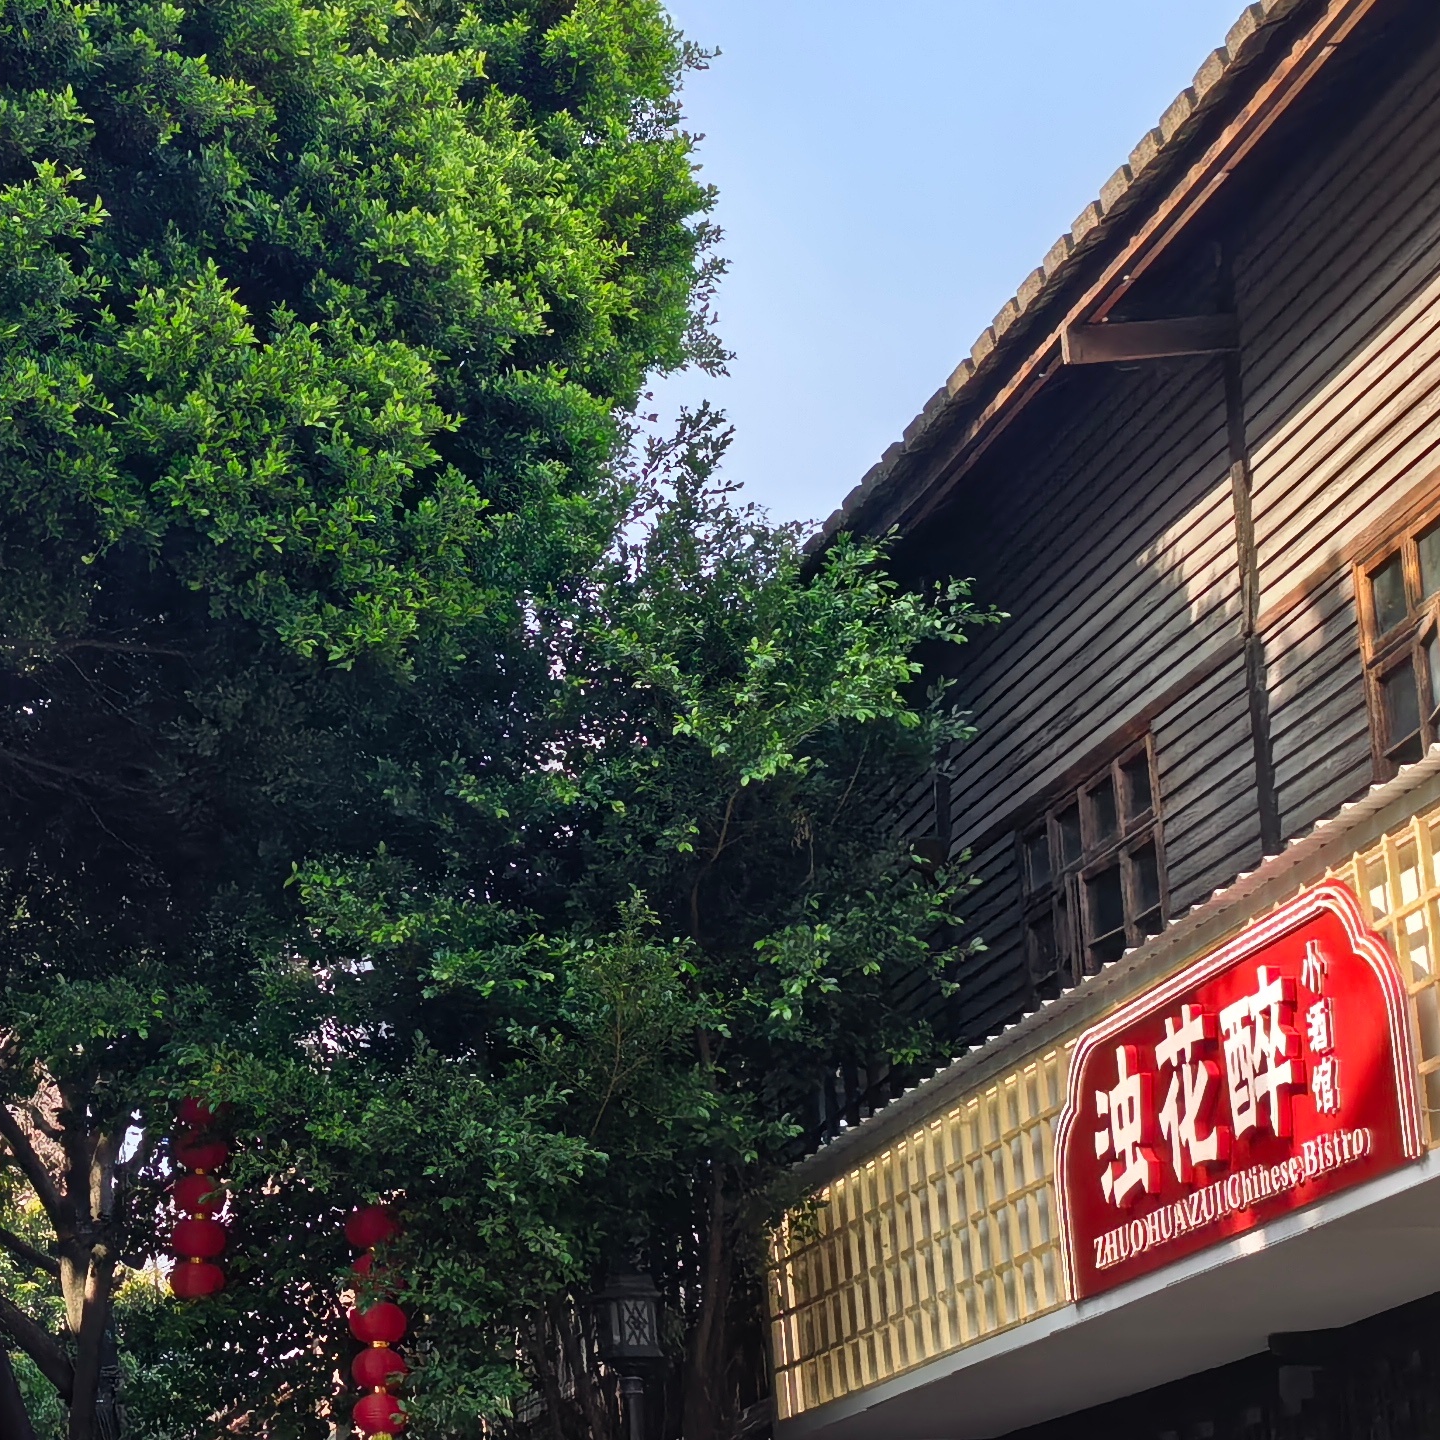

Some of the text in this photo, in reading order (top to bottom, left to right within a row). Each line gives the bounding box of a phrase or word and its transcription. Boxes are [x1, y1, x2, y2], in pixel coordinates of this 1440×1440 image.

[1095, 965, 1294, 1208] 浊花醉
[1302, 940, 1342, 1115] 小酒馆
